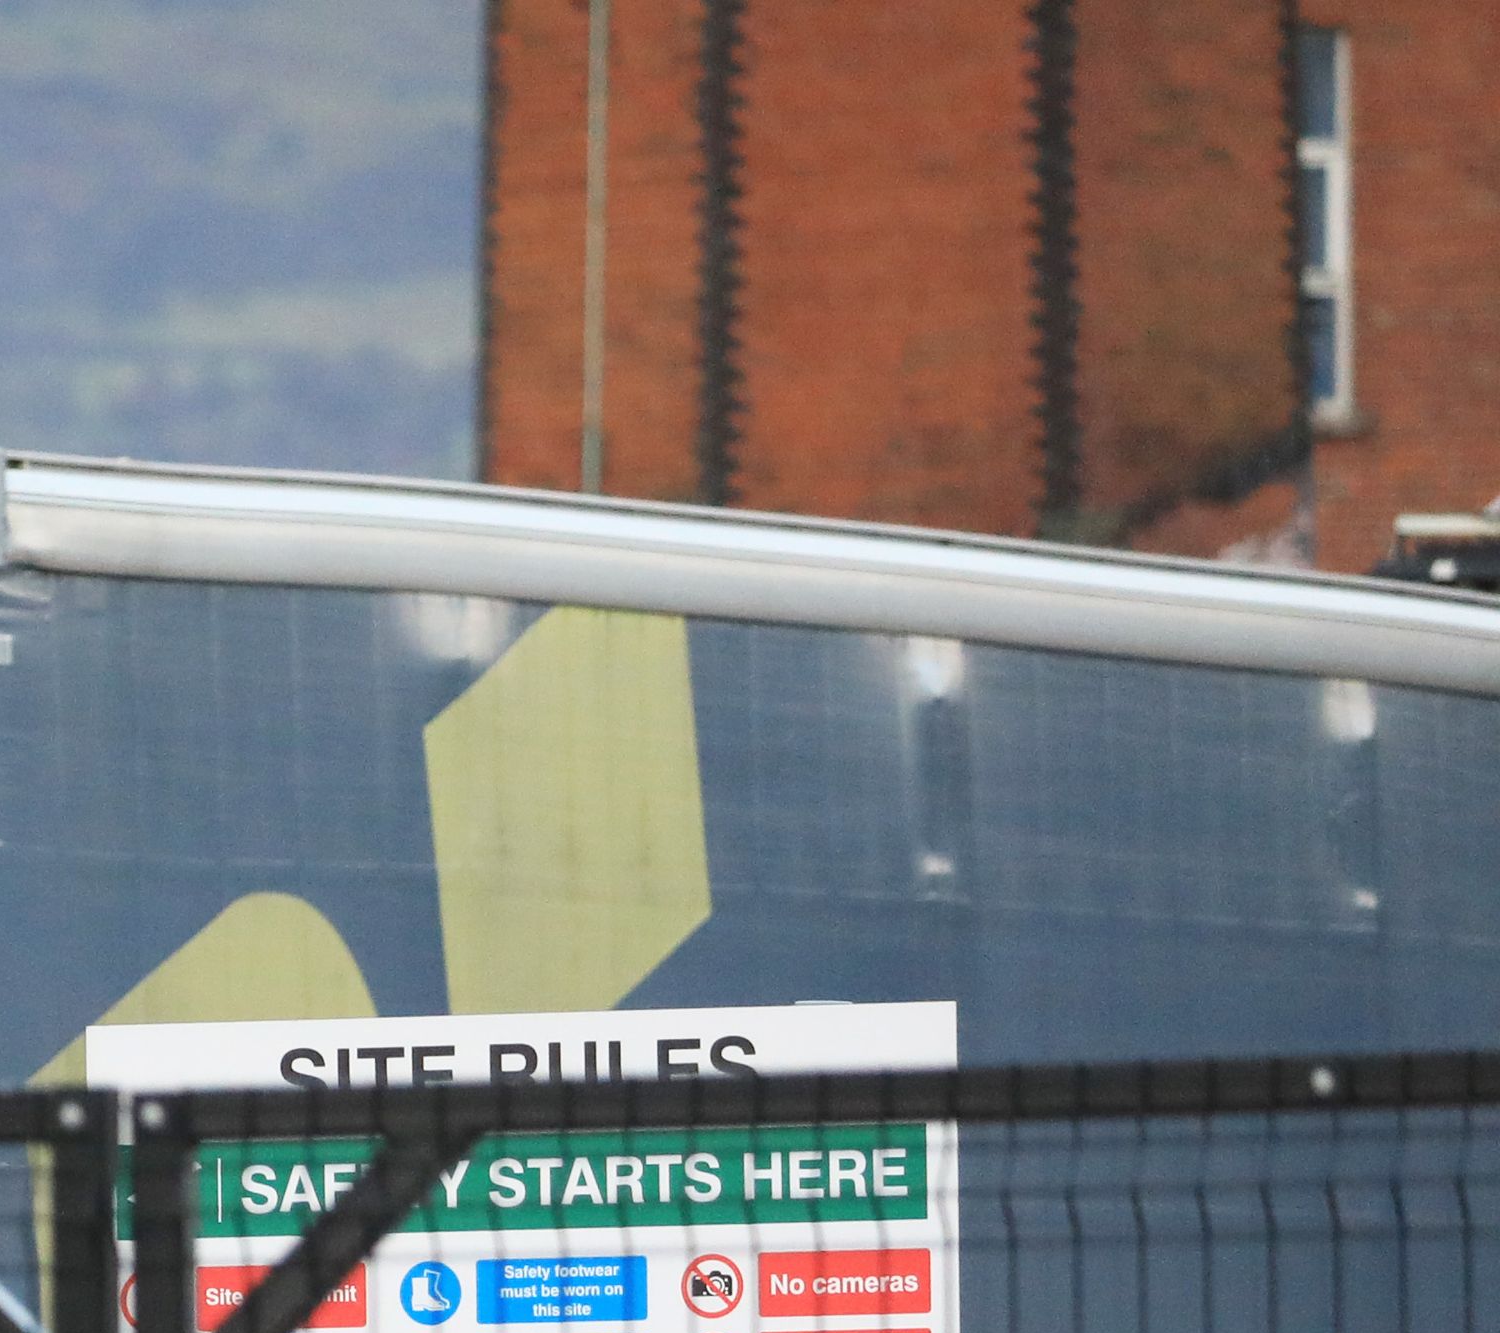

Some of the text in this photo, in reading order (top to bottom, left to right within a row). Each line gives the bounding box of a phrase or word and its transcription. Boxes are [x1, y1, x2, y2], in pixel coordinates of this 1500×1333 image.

[280, 1035, 757, 1090] SITE RULES
[241, 1147, 909, 1214] SAFY STARTS HERE
[504, 1264, 619, 1280] Safety footwear
[500, 1284, 623, 1298] must be worn on
[770, 1274, 918, 1295] No cameras
[205, 1288, 243, 1306] Site
[533, 1304, 591, 1316] this site
